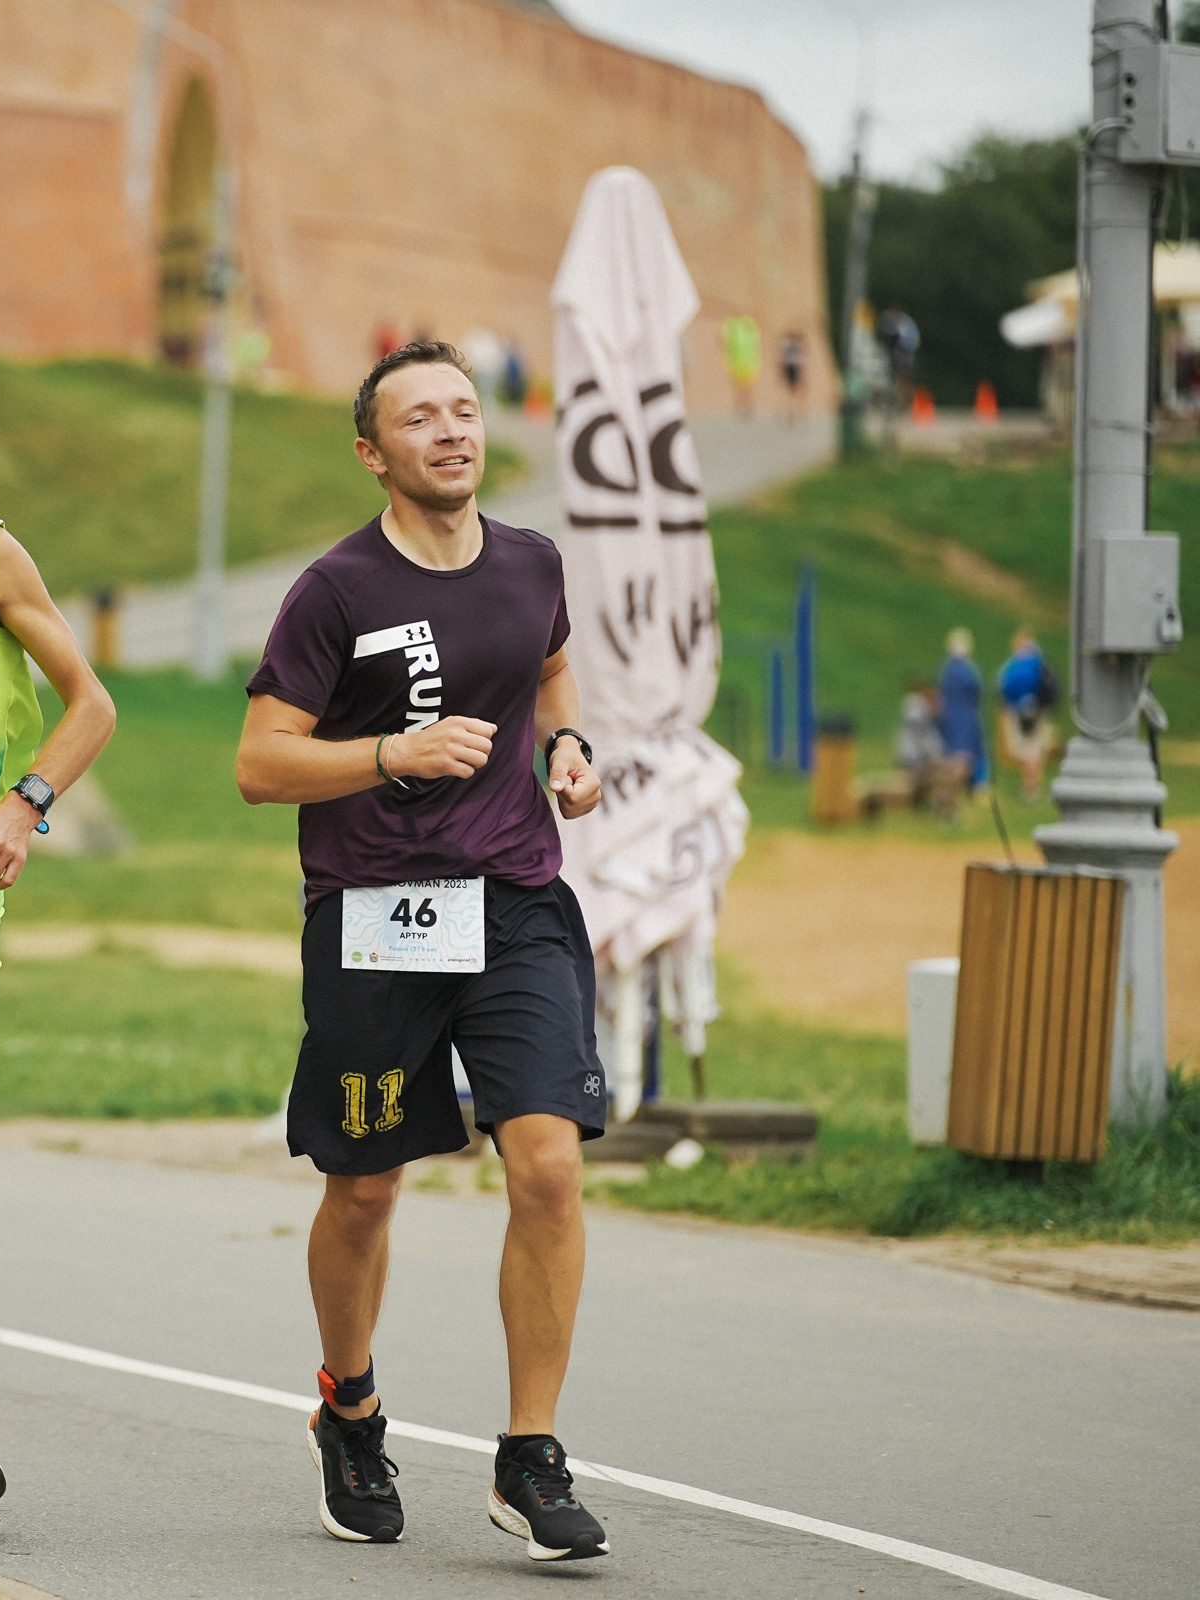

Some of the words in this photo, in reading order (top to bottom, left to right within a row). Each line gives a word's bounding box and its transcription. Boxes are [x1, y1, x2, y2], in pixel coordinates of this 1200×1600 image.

[443, 879, 468, 889] 2023
[390, 898, 437, 928] 46
[399, 932, 428, 940] АРТУР
[340, 1068, 404, 1139] 11
